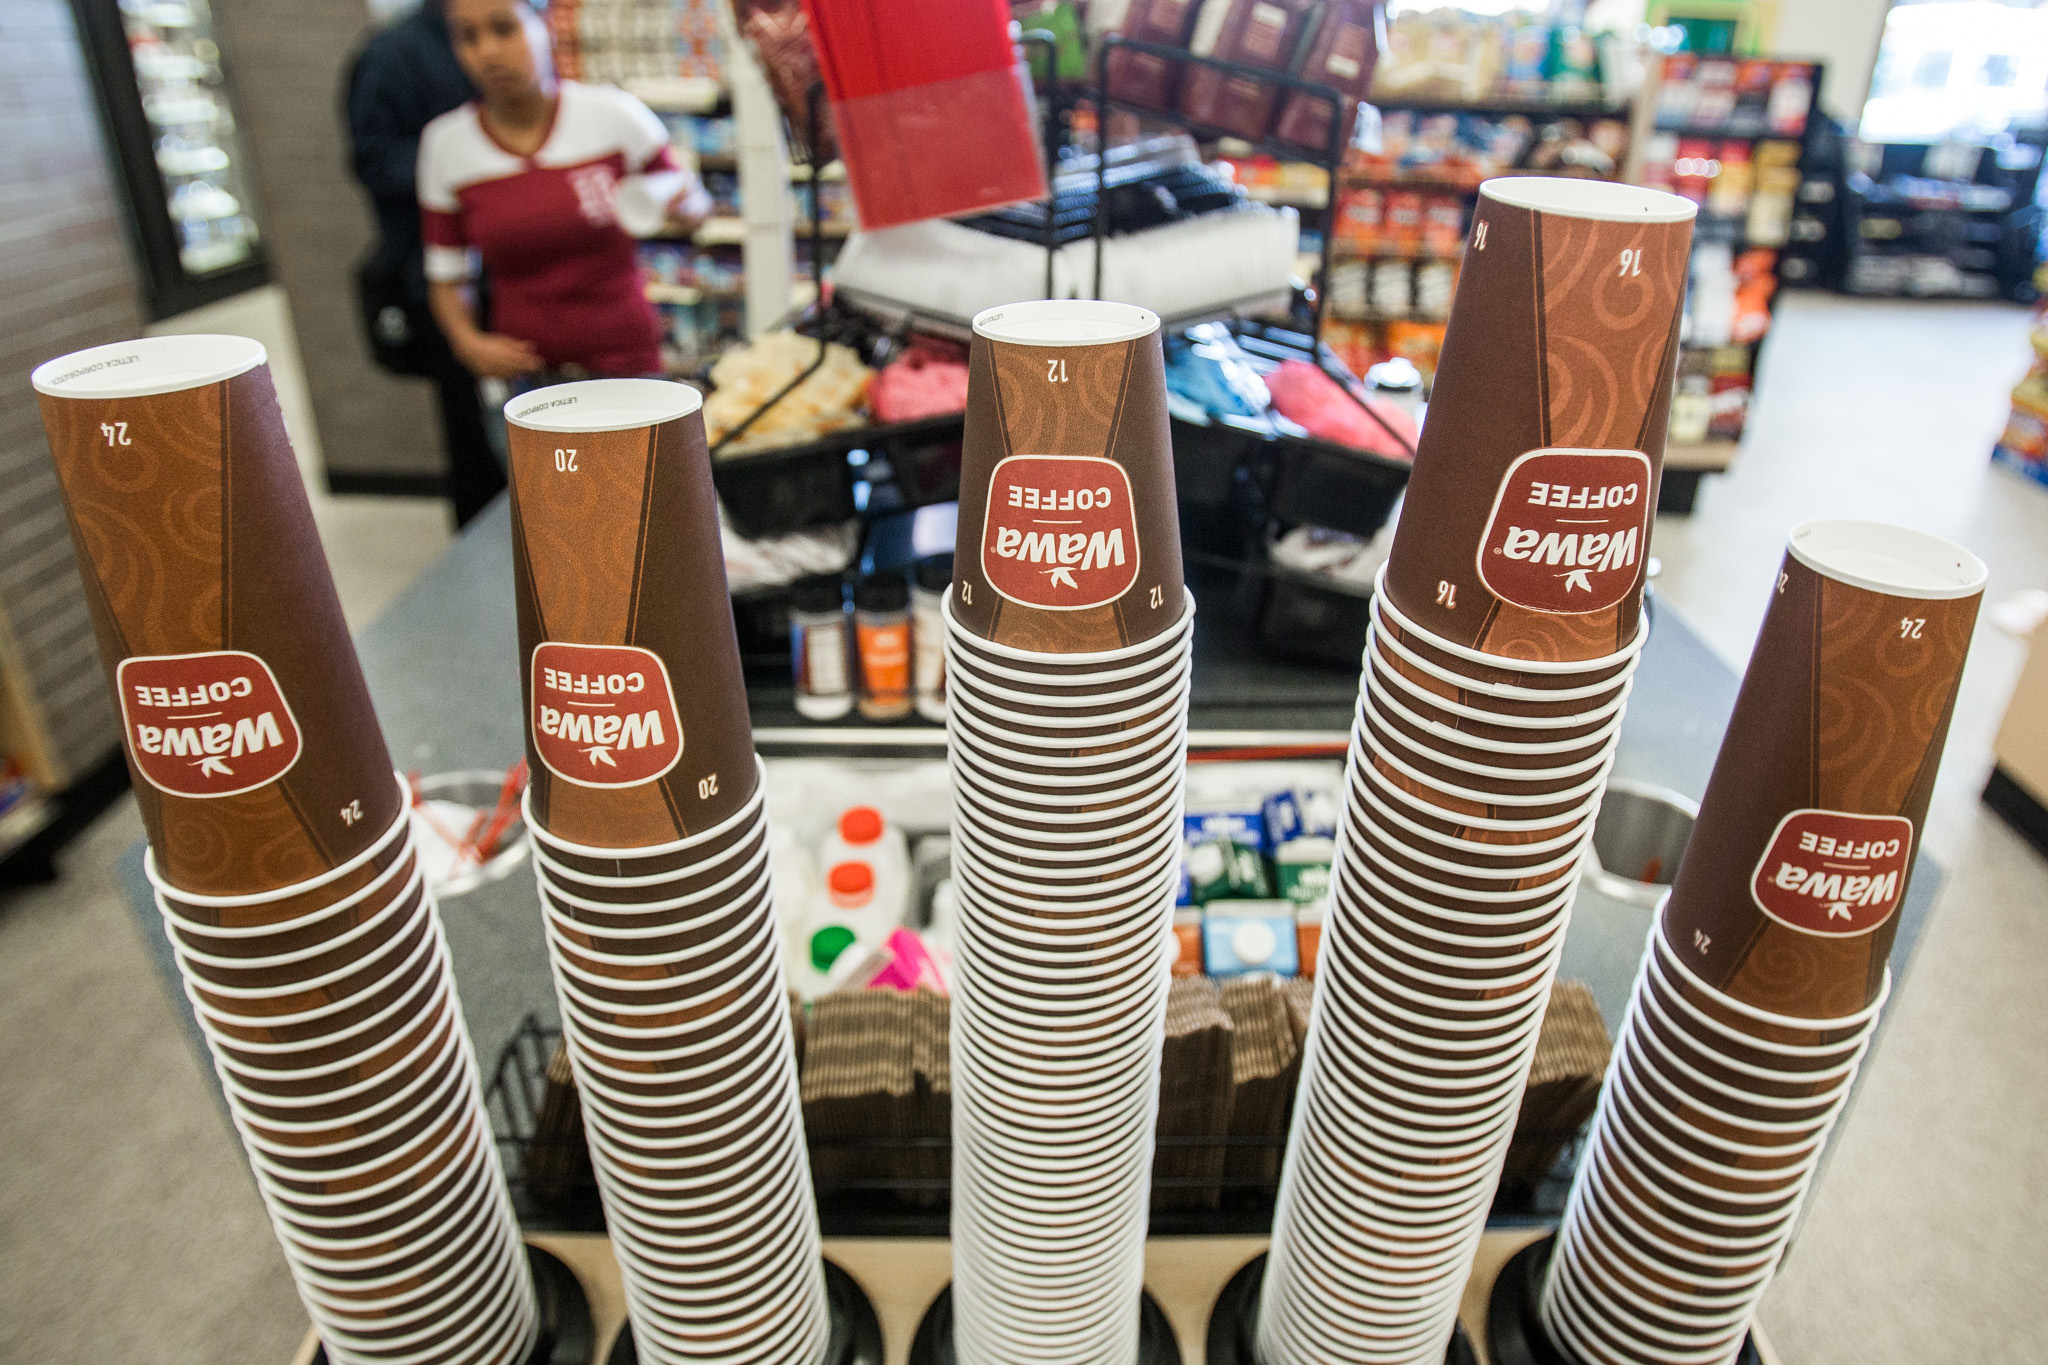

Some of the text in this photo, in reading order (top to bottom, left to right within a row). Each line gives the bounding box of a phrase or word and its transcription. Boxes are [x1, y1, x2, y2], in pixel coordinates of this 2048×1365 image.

[1474, 220, 1489, 250] 16
[1619, 248, 1642, 277] 16
[106, 354, 140, 368] LETICA
[1047, 359, 1069, 383] 12
[550, 396, 578, 408] LETICA
[100, 422, 132, 447] 24
[554, 448, 578, 472] 20
[1008, 484, 1112, 511] COFFEE
[1527, 481, 1638, 509] COFFEE
[996, 526, 1126, 571] Wawa
[1503, 526, 1638, 573] Wawa
[961, 580, 973, 606] 12
[1150, 584, 1164, 610] 12
[1436, 580, 1457, 609] 16
[1900, 616, 1926, 640] 24
[134, 676, 253, 708] COFFEE
[544, 667, 645, 695] COFFEE
[136, 711, 285, 758] Wawa
[540, 704, 666, 751] Wawa
[698, 773, 719, 800] 20
[340, 799, 364, 826] 24
[1798, 831, 1900, 860] COFFEE
[1775, 861, 1898, 907] Wawa
